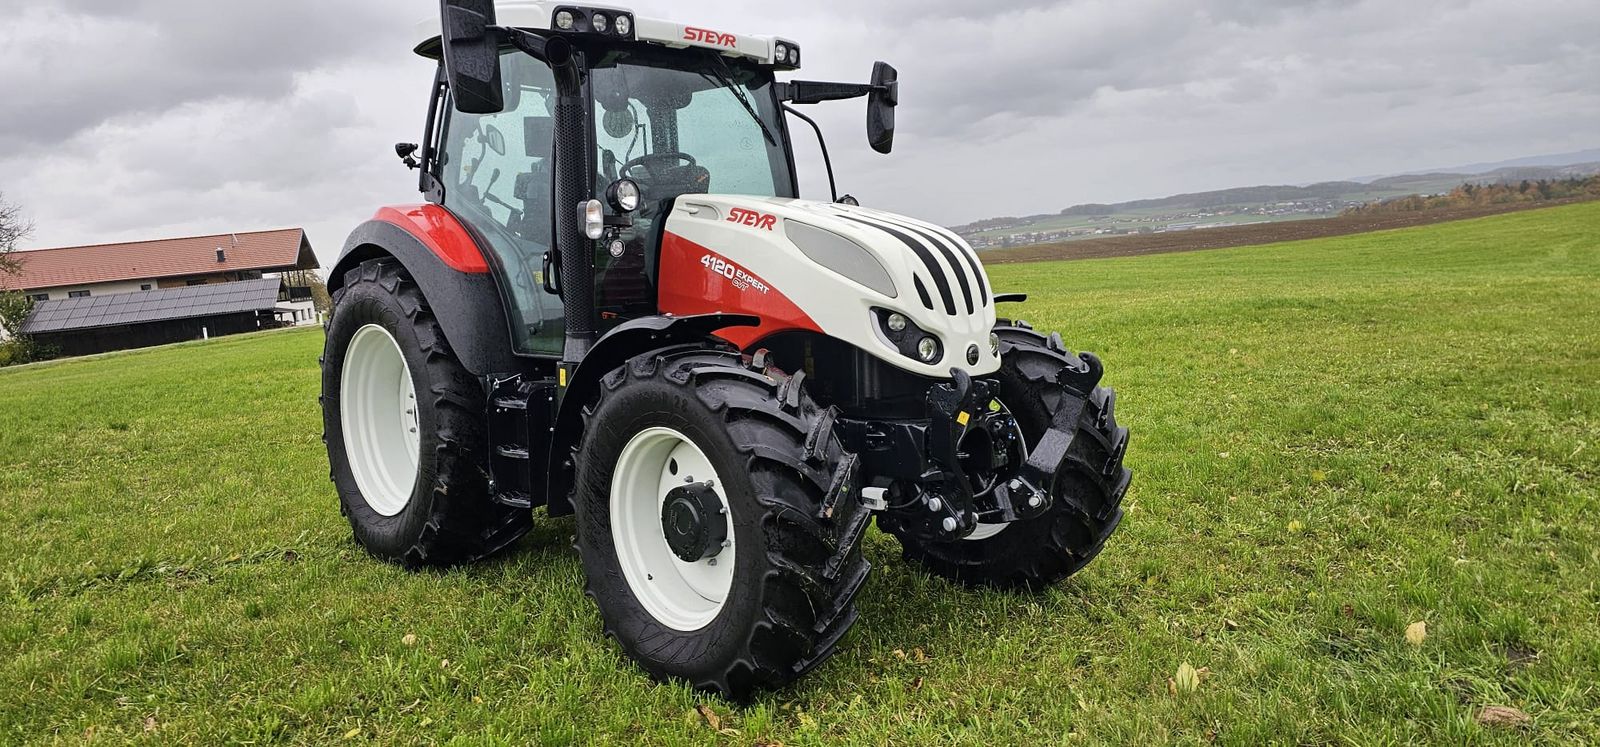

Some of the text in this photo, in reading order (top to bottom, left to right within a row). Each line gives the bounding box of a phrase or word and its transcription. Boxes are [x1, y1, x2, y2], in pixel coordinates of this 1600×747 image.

[684, 26, 736, 47] STEYR
[727, 207, 776, 231] STEYR
[701, 254, 769, 294] 4120 EXPERT
